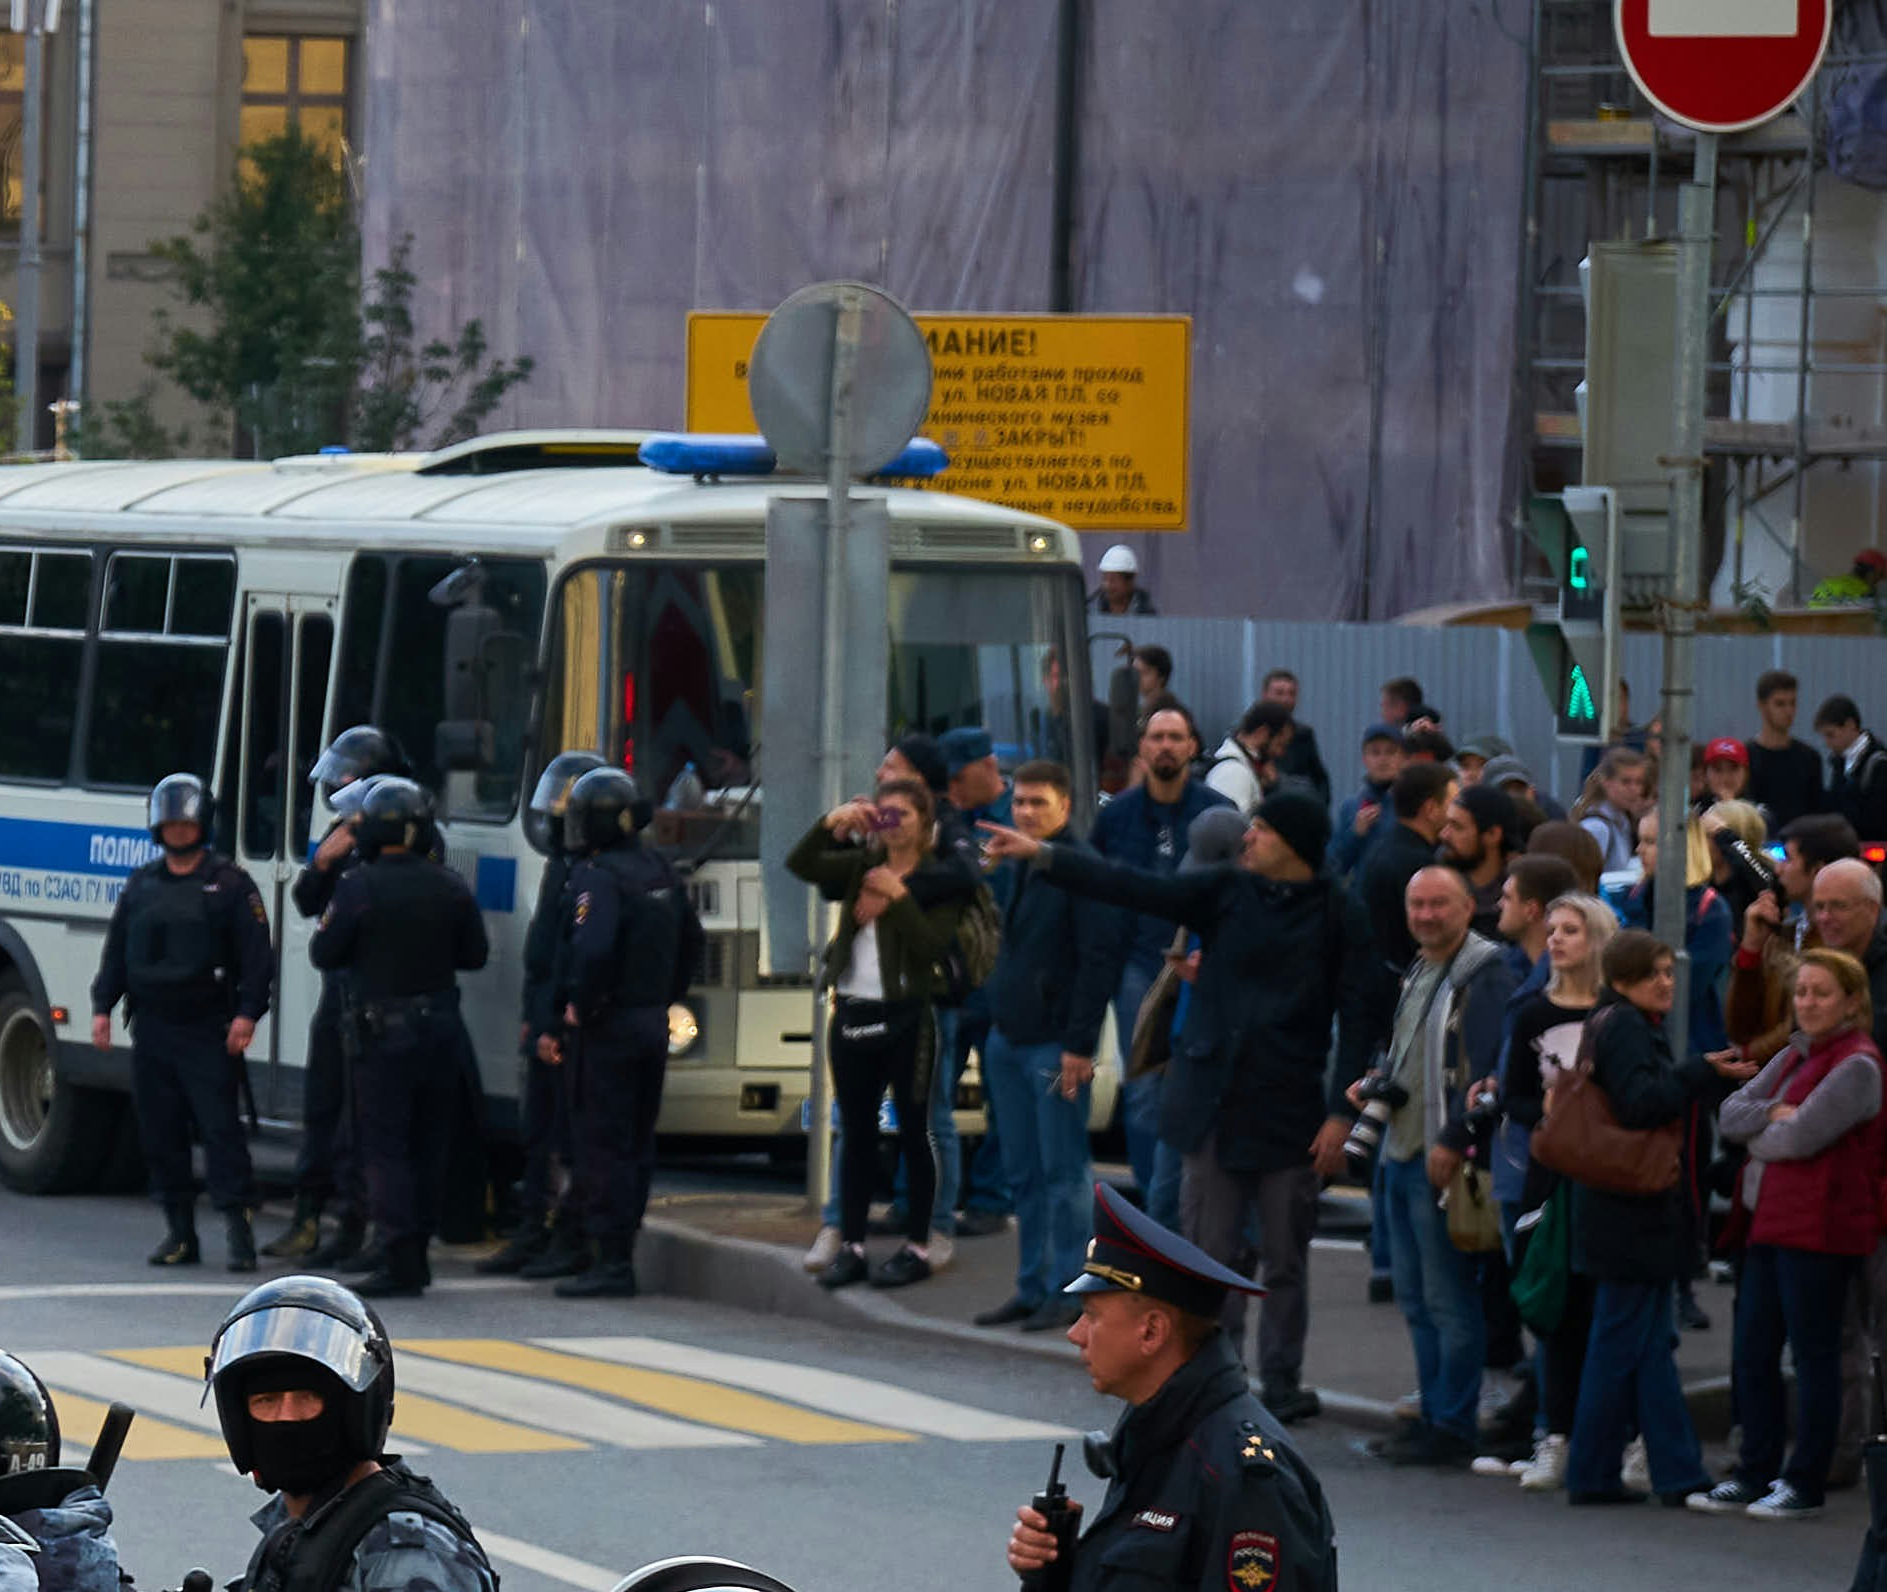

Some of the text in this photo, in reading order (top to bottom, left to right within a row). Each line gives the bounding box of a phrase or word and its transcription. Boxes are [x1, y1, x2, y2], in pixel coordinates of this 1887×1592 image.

[976, 385, 1048, 402] НОВАЯ
[1036, 473, 1110, 490] НОВАЯ
[24, 880, 40, 897] по
[43, 875, 82, 903] СЗАО
